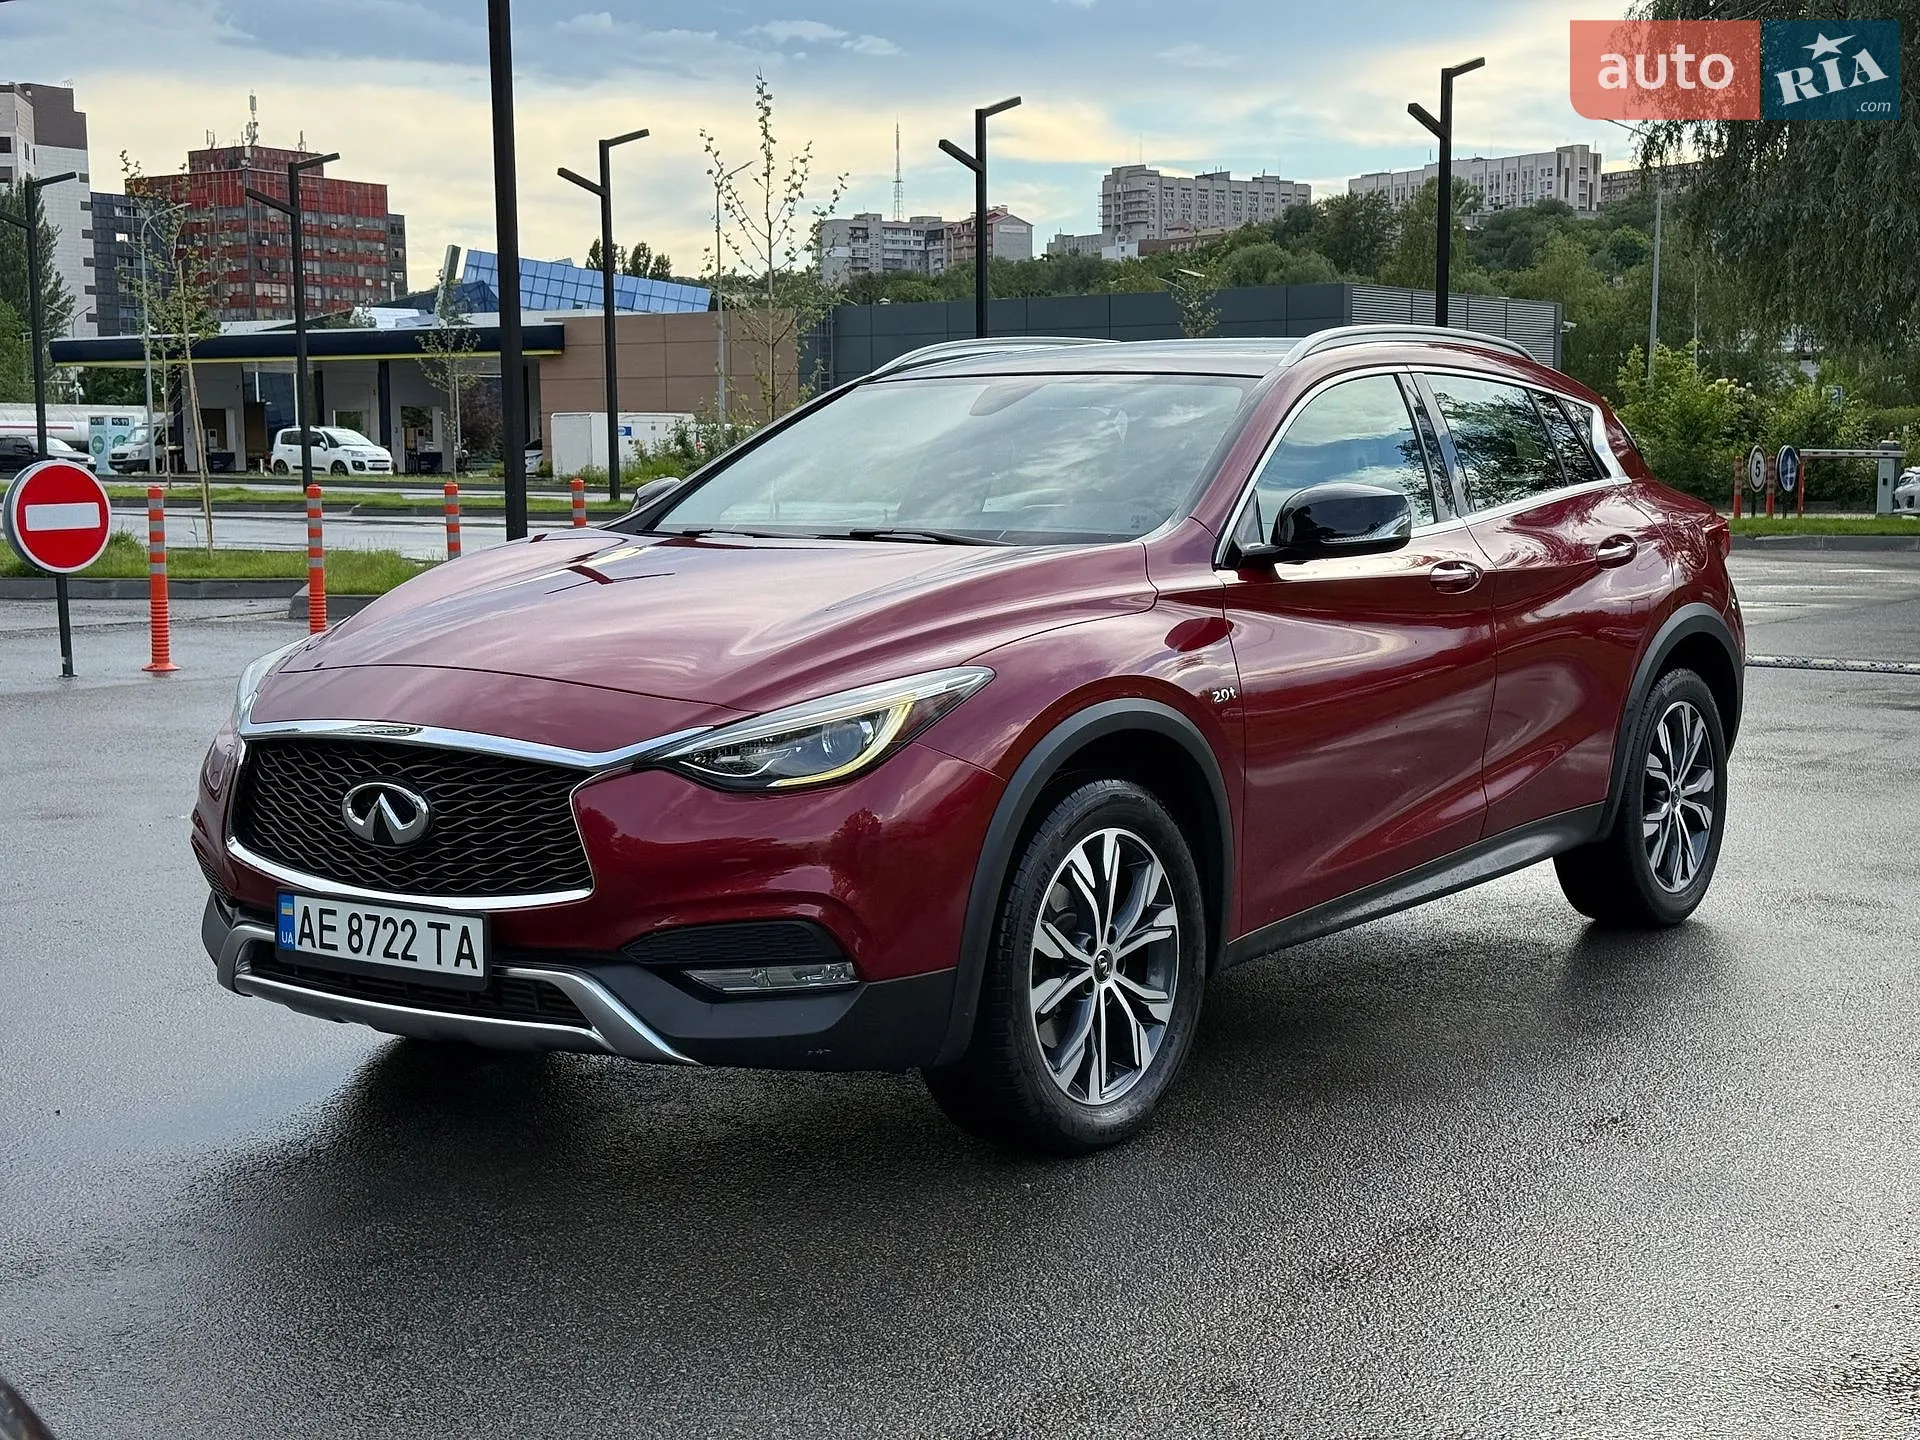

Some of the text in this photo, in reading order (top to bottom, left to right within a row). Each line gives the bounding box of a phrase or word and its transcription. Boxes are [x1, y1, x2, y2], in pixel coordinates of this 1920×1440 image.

[1755, 460, 1761, 478] 5
[281, 930, 295, 945] UA
[298, 905, 478, 970] AE 8722 TA
